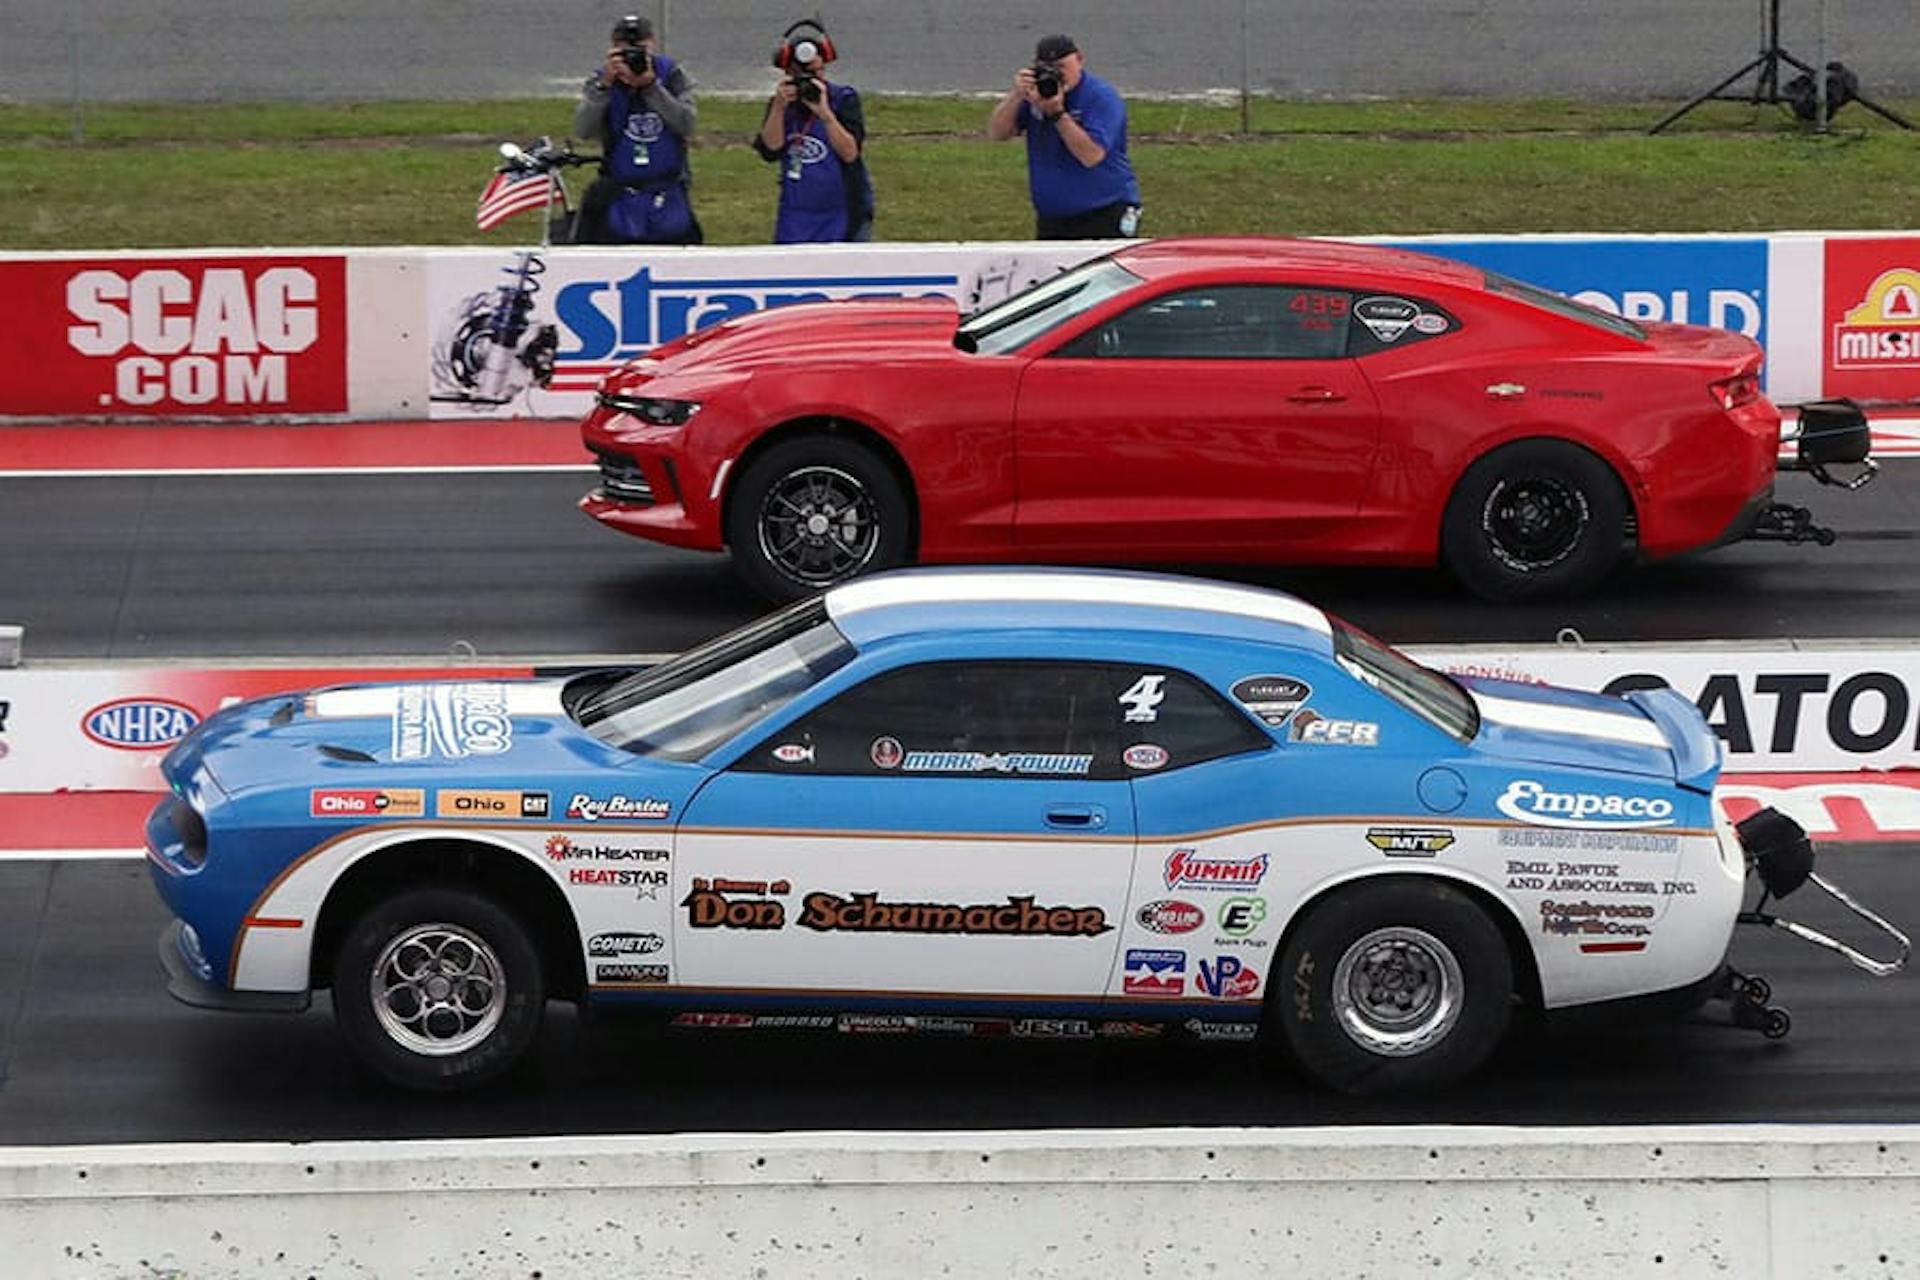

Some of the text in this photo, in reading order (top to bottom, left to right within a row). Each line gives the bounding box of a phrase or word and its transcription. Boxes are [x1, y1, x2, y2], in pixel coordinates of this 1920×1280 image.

[66, 267, 319, 356] SCAG
[1288, 294, 1348, 317] 439
[99, 355, 288, 405] .COM
[1119, 675, 1165, 715] 4
[100, 706, 188, 742] NHRA
[321, 796, 366, 811] Ohio
[454, 796, 507, 812] Ohio
[523, 798, 548, 812] CAT
[569, 793, 608, 821] Ray
[1496, 779, 1676, 829] Empaco
[595, 846, 670, 861] HEATER
[570, 869, 668, 885] HEATSTAR
[1166, 852, 1265, 884] SUMMIT
[1507, 860, 1620, 878] EMIL PAWUK
[1506, 877, 1545, 891] AND
[684, 891, 1112, 934] Don Schumacher
[590, 936, 664, 953] COMETIC
[1199, 955, 1241, 996] VP
